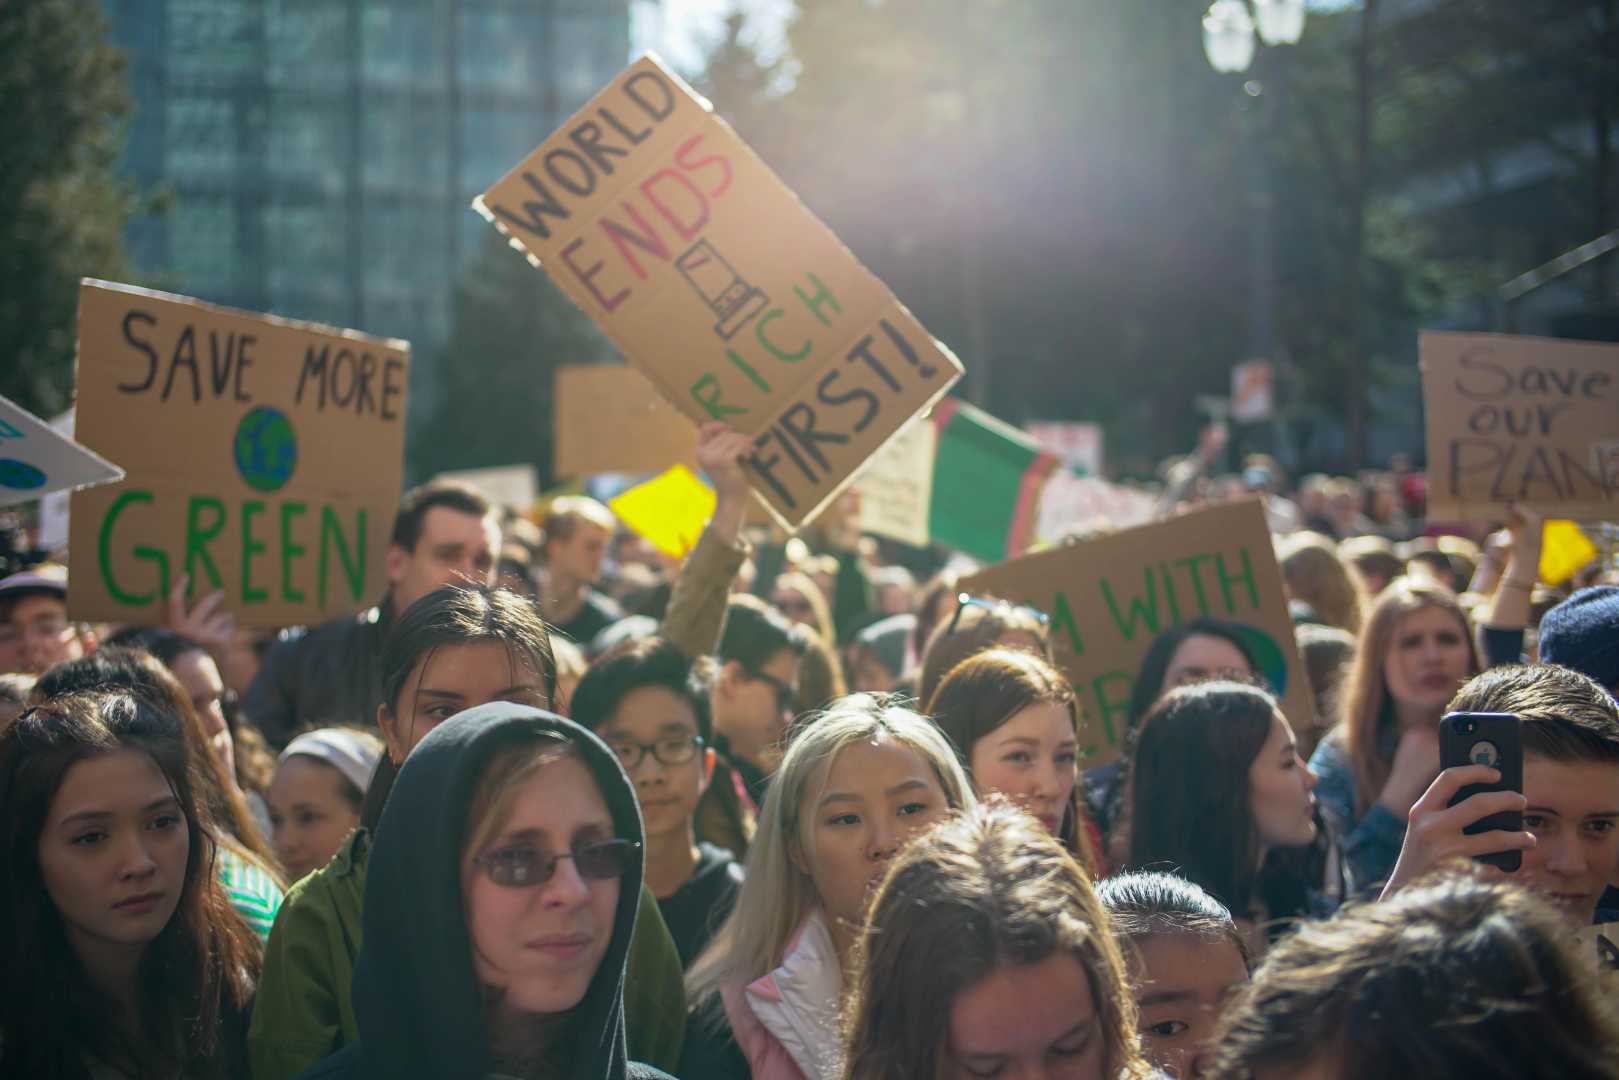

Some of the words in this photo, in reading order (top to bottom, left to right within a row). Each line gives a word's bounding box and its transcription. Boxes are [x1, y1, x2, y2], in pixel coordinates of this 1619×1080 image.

[493, 70, 676, 240] WORLD
[560, 135, 734, 313] ENDS
[117, 310, 257, 403] SAVE
[296, 343, 404, 421] MORE
[689, 272, 844, 420] RICH
[1455, 345, 1613, 399] Save
[739, 319, 938, 511] FIRST!
[1449, 438, 1619, 502] PLAN
[1468, 404, 1577, 438] our
[97, 489, 368, 611] GREEN
[1099, 545, 1262, 642] WITH
